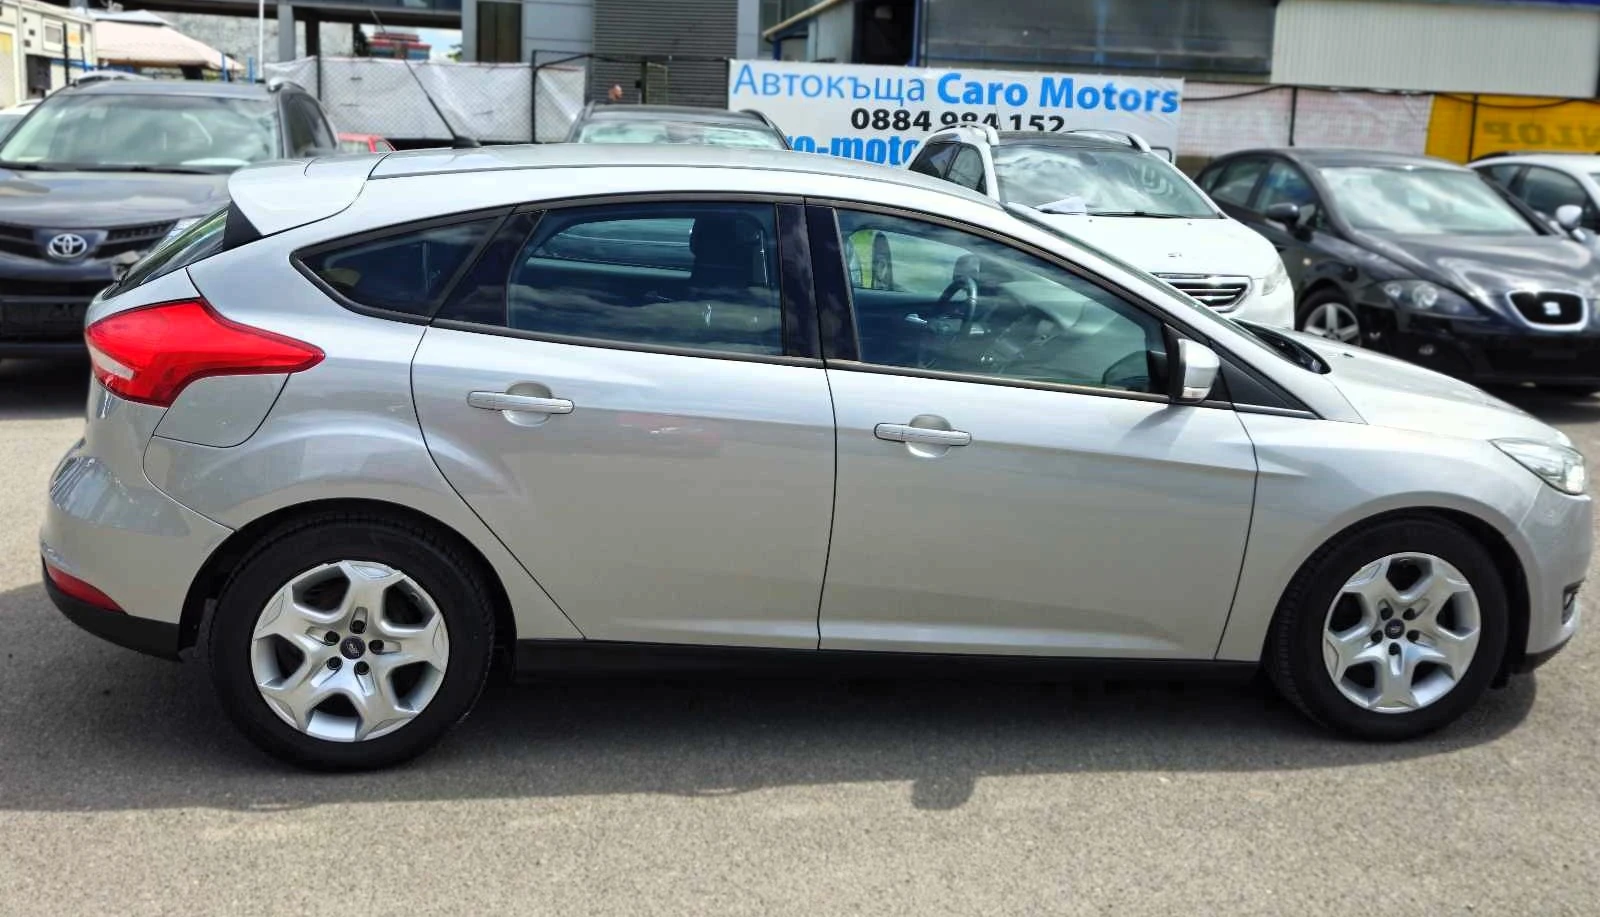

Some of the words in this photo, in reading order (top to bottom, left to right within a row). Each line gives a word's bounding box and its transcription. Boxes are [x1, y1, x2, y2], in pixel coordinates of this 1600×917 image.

[734, 64, 925, 106] Автокъща
[937, 73, 1028, 106] Caro
[1040, 77, 1178, 112] Motors
[851, 108, 931, 131] 0884
